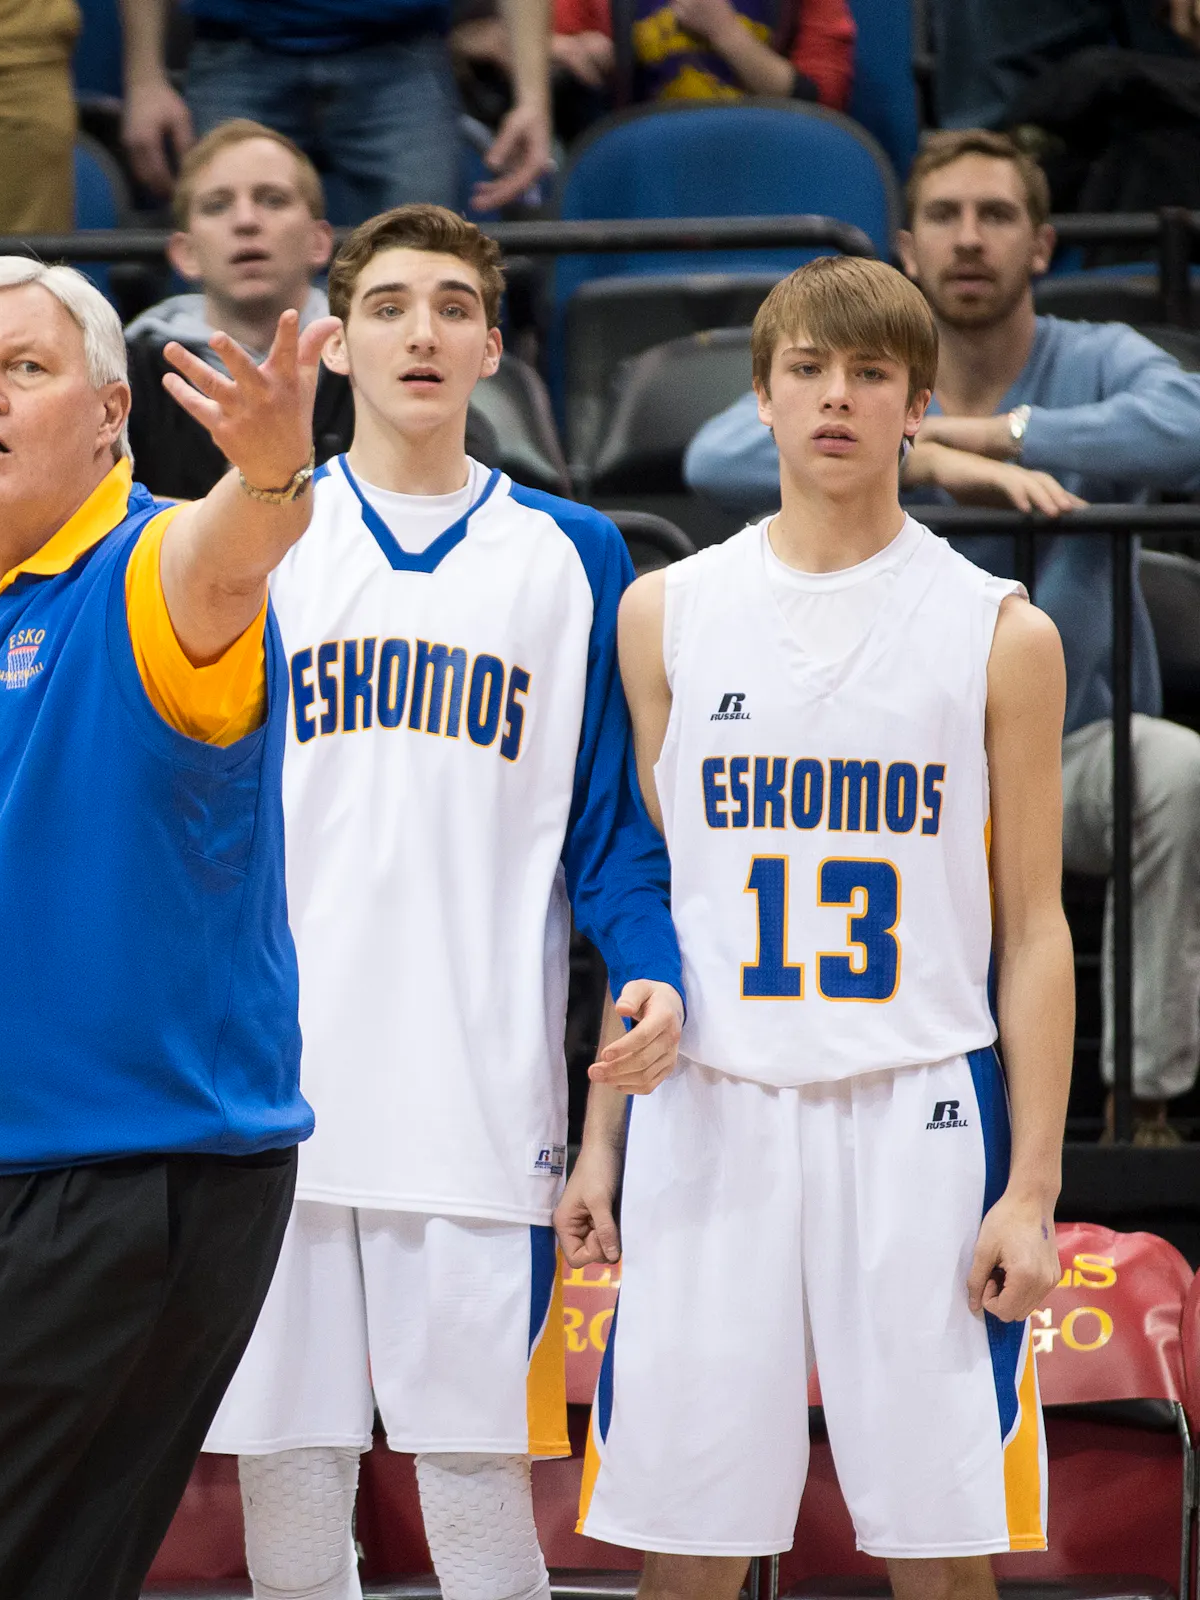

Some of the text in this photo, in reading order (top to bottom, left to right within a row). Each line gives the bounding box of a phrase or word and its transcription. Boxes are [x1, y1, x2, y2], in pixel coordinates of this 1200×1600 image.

[9, 628, 46, 649] ESKO
[290, 634, 532, 764] ESKOMOS
[710, 711, 752, 721] RUSSELL
[702, 755, 947, 837] ESKOMOS
[740, 854, 901, 1004] 13
[925, 1119, 969, 1130] RUSSELL
